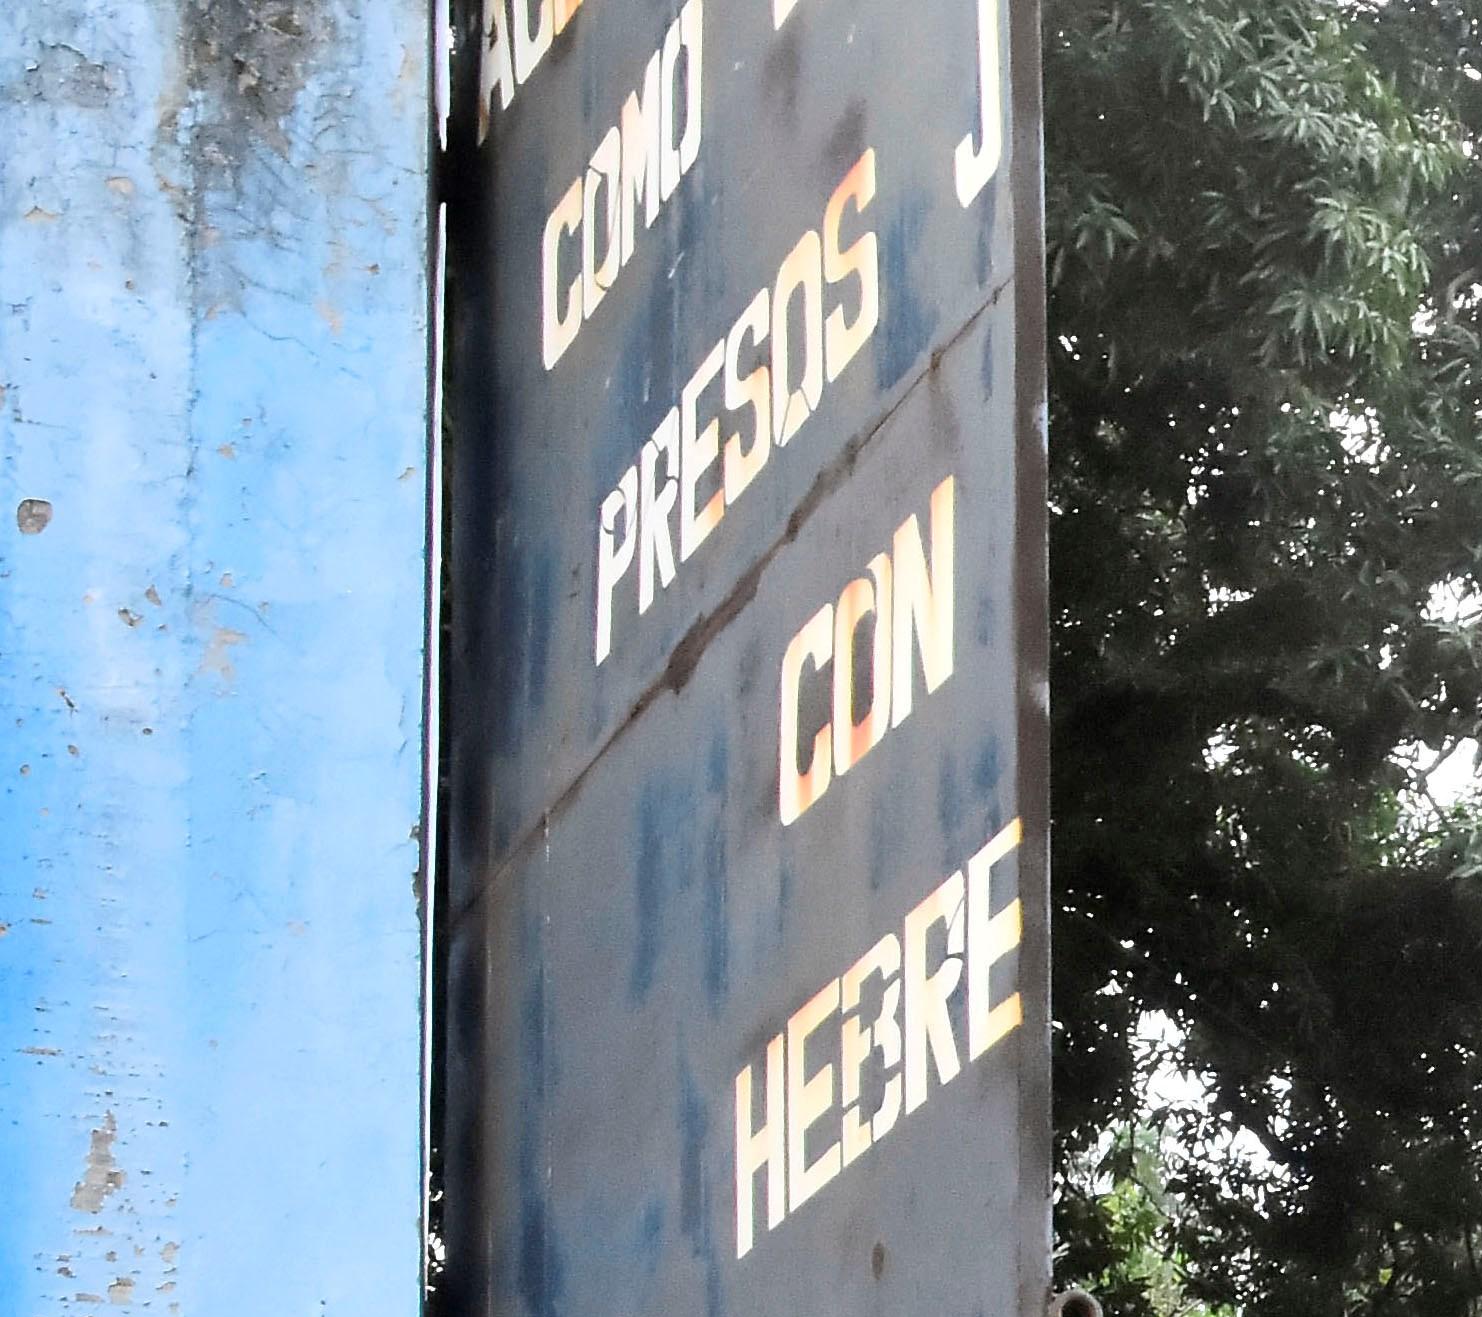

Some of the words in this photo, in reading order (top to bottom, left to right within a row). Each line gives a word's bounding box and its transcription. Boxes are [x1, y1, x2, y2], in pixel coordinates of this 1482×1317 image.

[542, 0, 702, 370] COMO
[596, 147, 880, 668] PRESOS
[779, 475, 956, 827] CON
